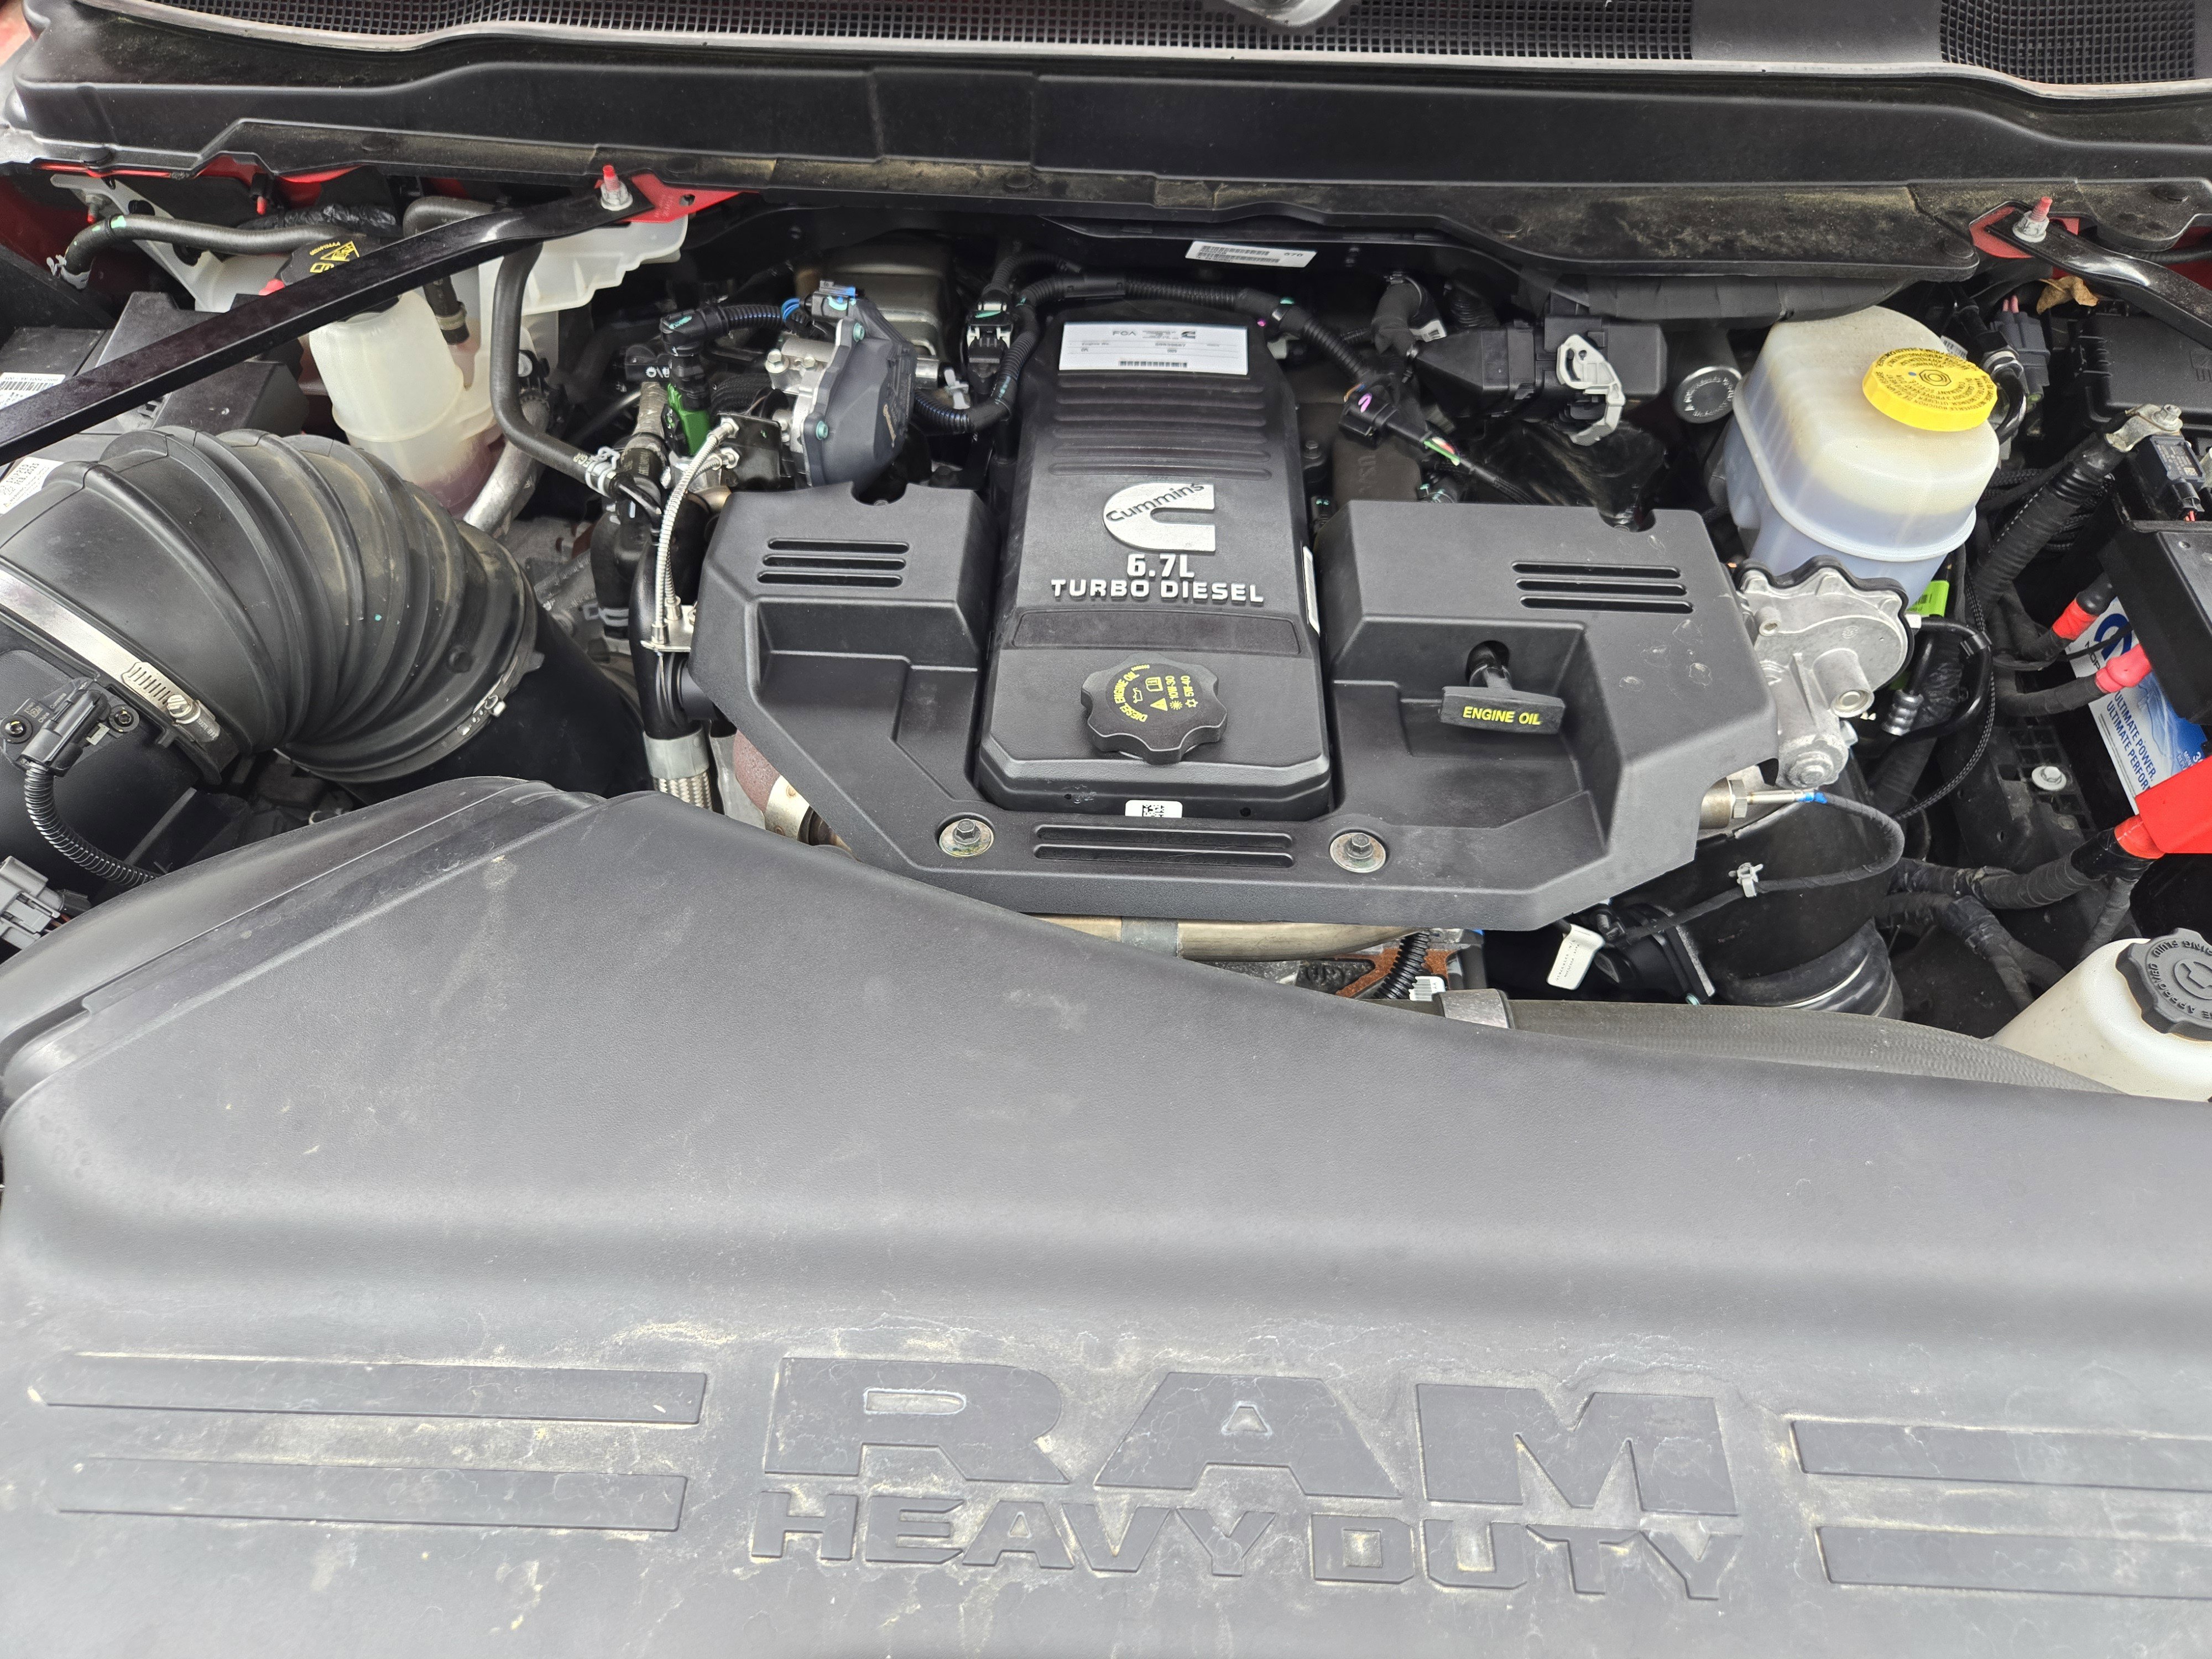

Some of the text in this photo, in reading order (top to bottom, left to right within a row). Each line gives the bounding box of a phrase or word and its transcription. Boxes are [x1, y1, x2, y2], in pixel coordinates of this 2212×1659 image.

[1106, 483, 1205, 521] Cummins
[1126, 553, 1196, 580] 6.7L
[1051, 578, 1265, 606] TURBO DIESEL
[1123, 671, 1140, 681] OIL
[1165, 675, 1179, 700] 10W-30
[1180, 675, 1194, 697] 5W-40
[1113, 679, 1129, 704] ENGINE
[1119, 702, 1148, 722] DIESEL
[1463, 706, 1542, 725] ENGINE OIL
[2106, 700, 2130, 752] ULTIMATE
[2114, 691, 2157, 782] ULTIMATE POWER.
[2152, 940, 2212, 957] RING FLUID
[2148, 963, 2197, 1014] APPROVED
[765, 1358, 1739, 1516] RAM
[751, 1491, 1743, 1600] HEAVY DUTY
